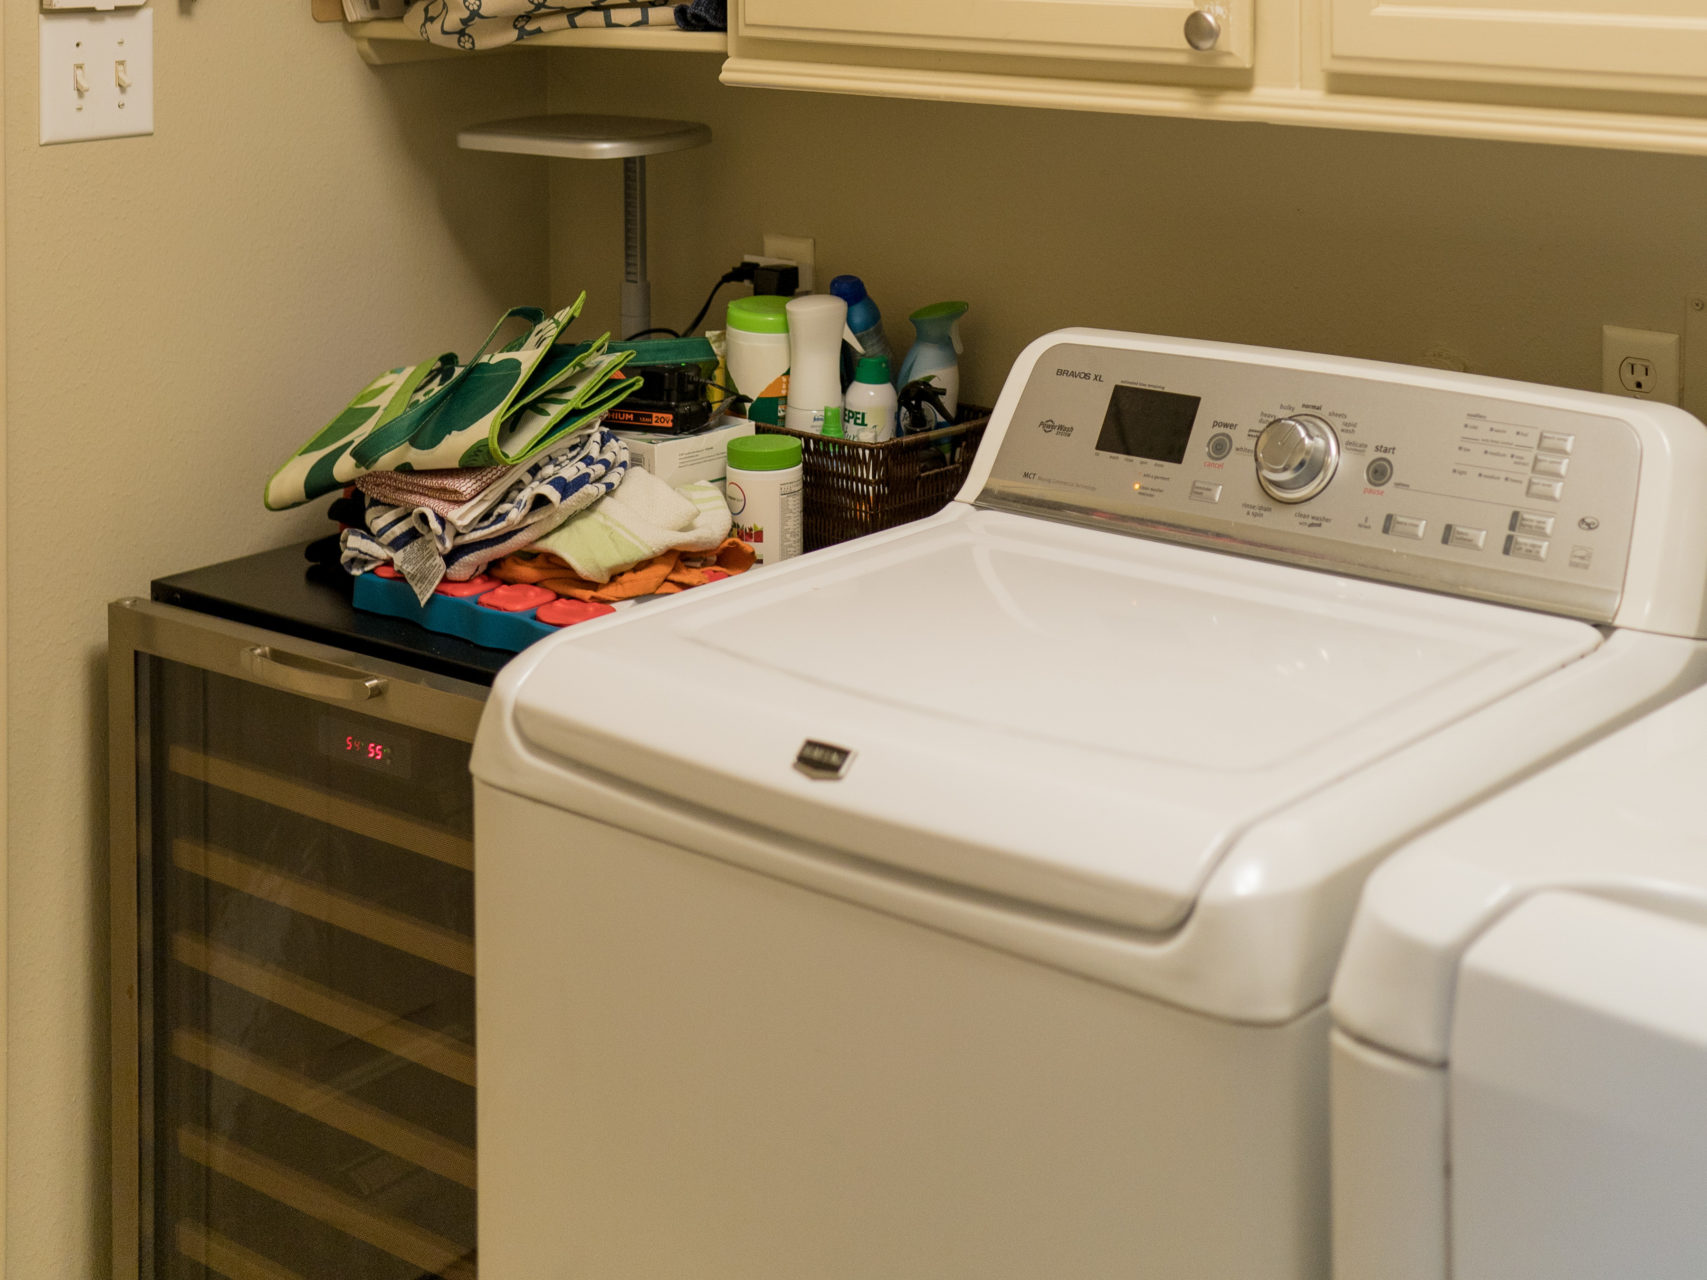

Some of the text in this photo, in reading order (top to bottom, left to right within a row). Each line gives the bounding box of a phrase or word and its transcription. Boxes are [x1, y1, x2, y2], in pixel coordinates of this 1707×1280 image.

[1056, 369, 1104, 383] BRAVOS XL
[1302, 403, 1322, 411] normal
[607, 412, 634, 421] HIUM
[843, 407, 868, 427] EPEL
[1038, 420, 1074, 433] PowerWash
[1212, 420, 1238, 431] power
[1374, 443, 1397, 455] start
[1203, 460, 1225, 470] cancel
[1022, 471, 1036, 480] MCT
[1363, 487, 1385, 497] pause
[367, 742, 384, 760] 55
